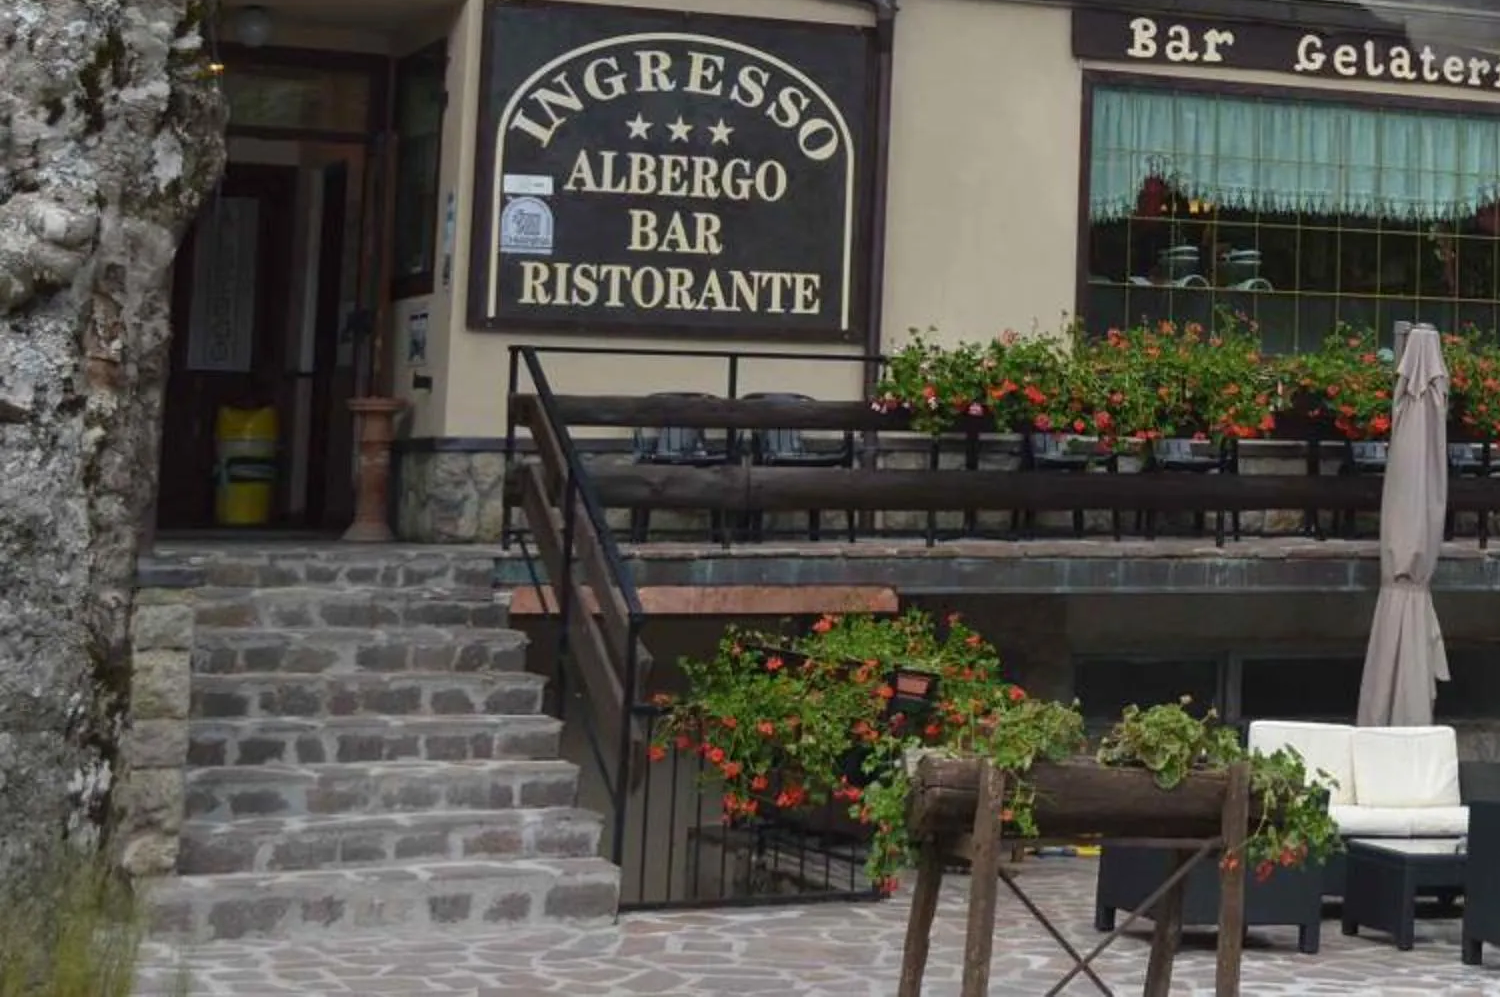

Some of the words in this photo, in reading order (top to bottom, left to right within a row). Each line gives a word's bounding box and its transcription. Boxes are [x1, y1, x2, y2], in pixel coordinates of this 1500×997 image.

[1126, 16, 1237, 63] Bar
[509, 49, 839, 162] INGRESSO
[563, 149, 788, 203] ALBERGO
[626, 208, 723, 255] BAR
[517, 260, 821, 315] RISTORANTE
